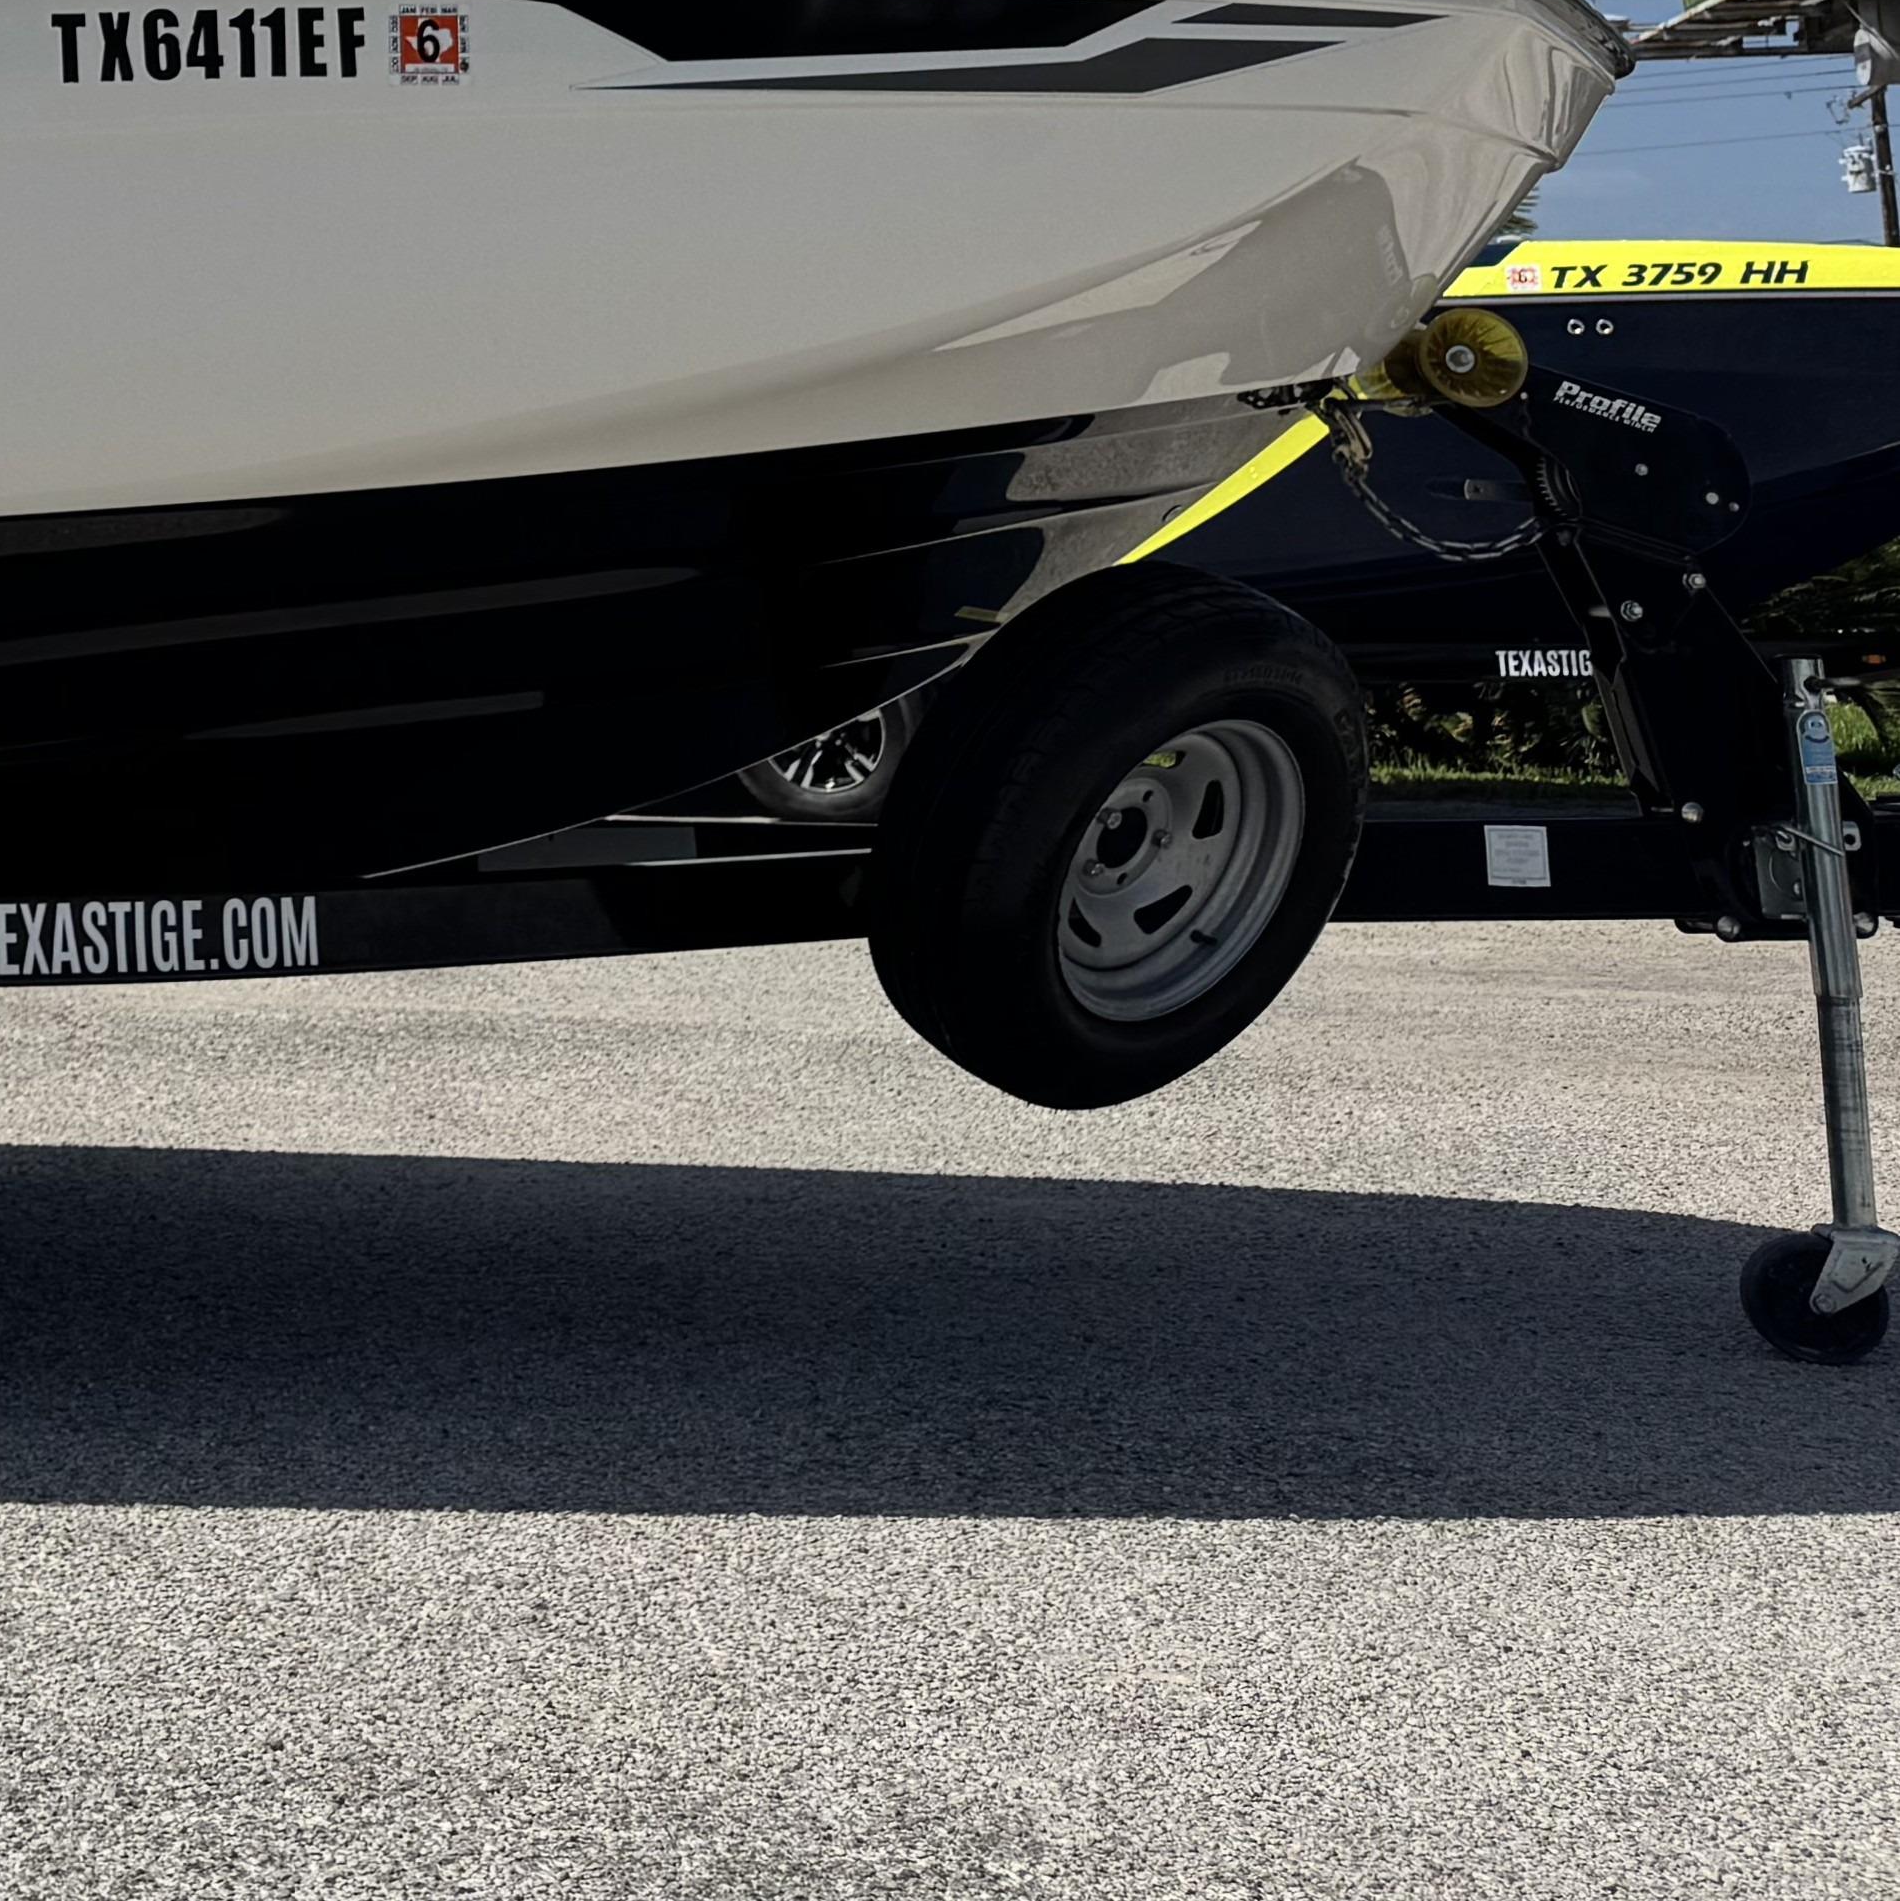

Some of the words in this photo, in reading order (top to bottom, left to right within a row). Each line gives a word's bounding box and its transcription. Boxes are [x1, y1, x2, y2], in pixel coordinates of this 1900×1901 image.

[51, 6, 365, 84] TX6411EF
[417, 19, 440, 63] 6
[1550, 264, 1608, 289] TX
[1621, 261, 1722, 287] 3759
[1740, 260, 1810, 284] HH
[1556, 380, 1661, 428] Profile
